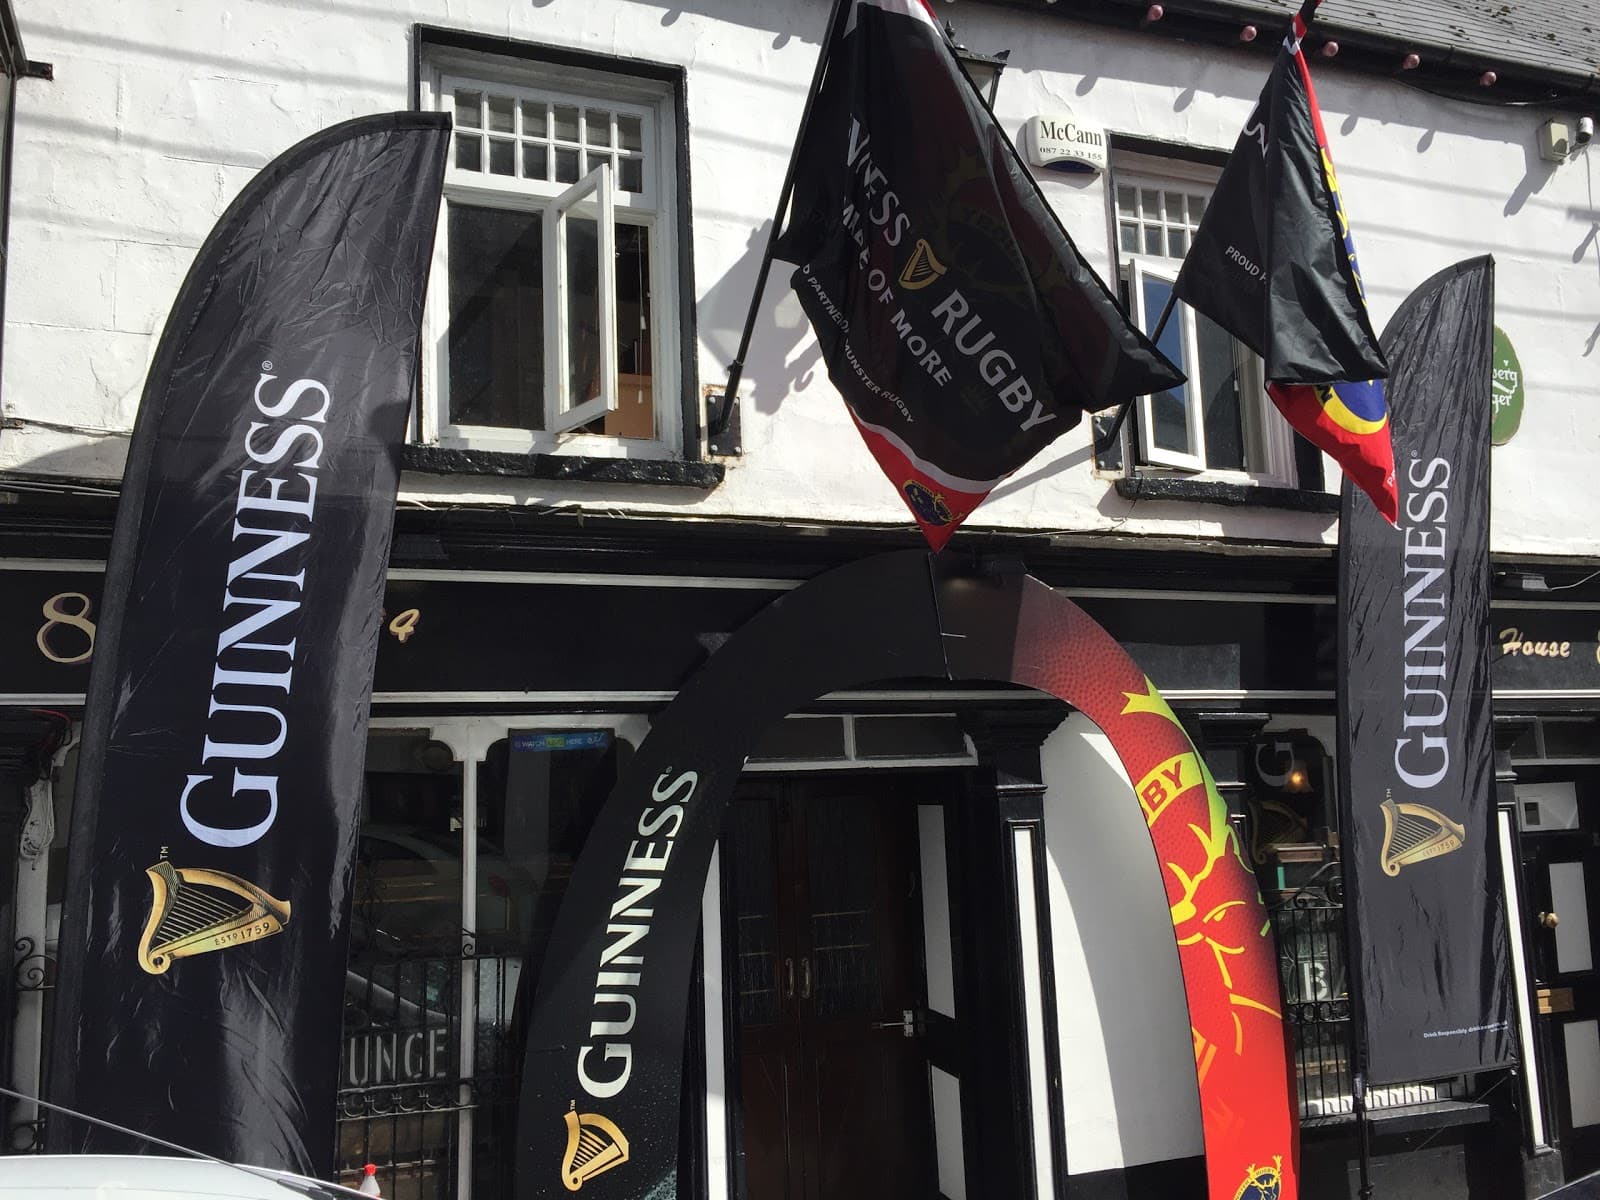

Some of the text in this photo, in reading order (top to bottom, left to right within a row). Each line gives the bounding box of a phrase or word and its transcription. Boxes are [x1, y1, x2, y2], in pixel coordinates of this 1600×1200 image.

[1039, 120, 1102, 147] McCann
[1059, 147, 1071, 157] 22
[1074, 149, 1085, 158] 33
[1087, 151, 1103, 161] 155
[1224, 245, 1260, 277] PROUD
[867, 268, 894, 304] OF
[890, 308, 952, 388] MORE
[930, 289, 1057, 433] RUGBY
[880, 390, 915, 424] RUGBY
[36, 592, 97, 664] 8
[179, 372, 331, 848] GUINNESS
[1393, 457, 1452, 789] GUINNESS
[1499, 626, 1571, 658] House
[241, 921, 270, 940] 1759
[576, 770, 699, 1099] GUINNESS
